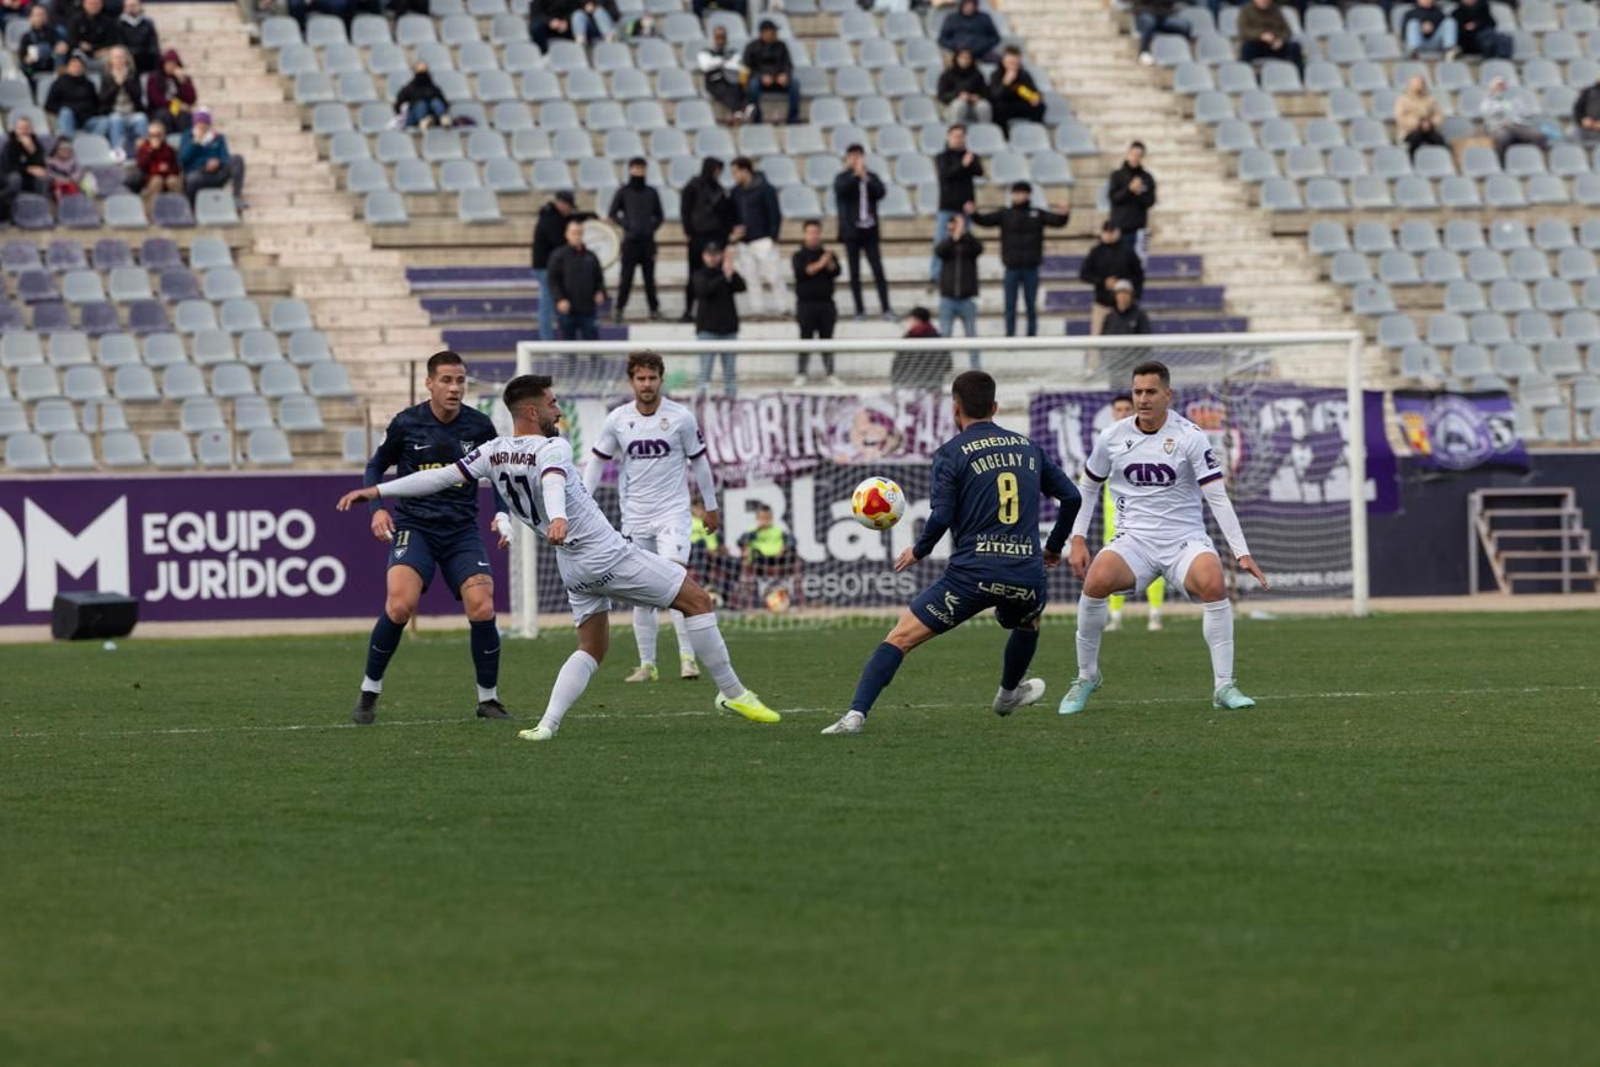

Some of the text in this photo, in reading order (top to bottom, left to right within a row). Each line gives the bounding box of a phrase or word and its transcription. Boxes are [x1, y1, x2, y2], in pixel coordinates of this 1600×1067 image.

[703, 393, 830, 463] NORTH
[997, 472, 1019, 524] 8
[0, 495, 130, 611] M
[143, 509, 315, 554] EQUIPO
[976, 534, 1032, 544] MURCIA
[145, 551, 346, 602] JURÍDICO
[757, 572, 917, 597] esores
